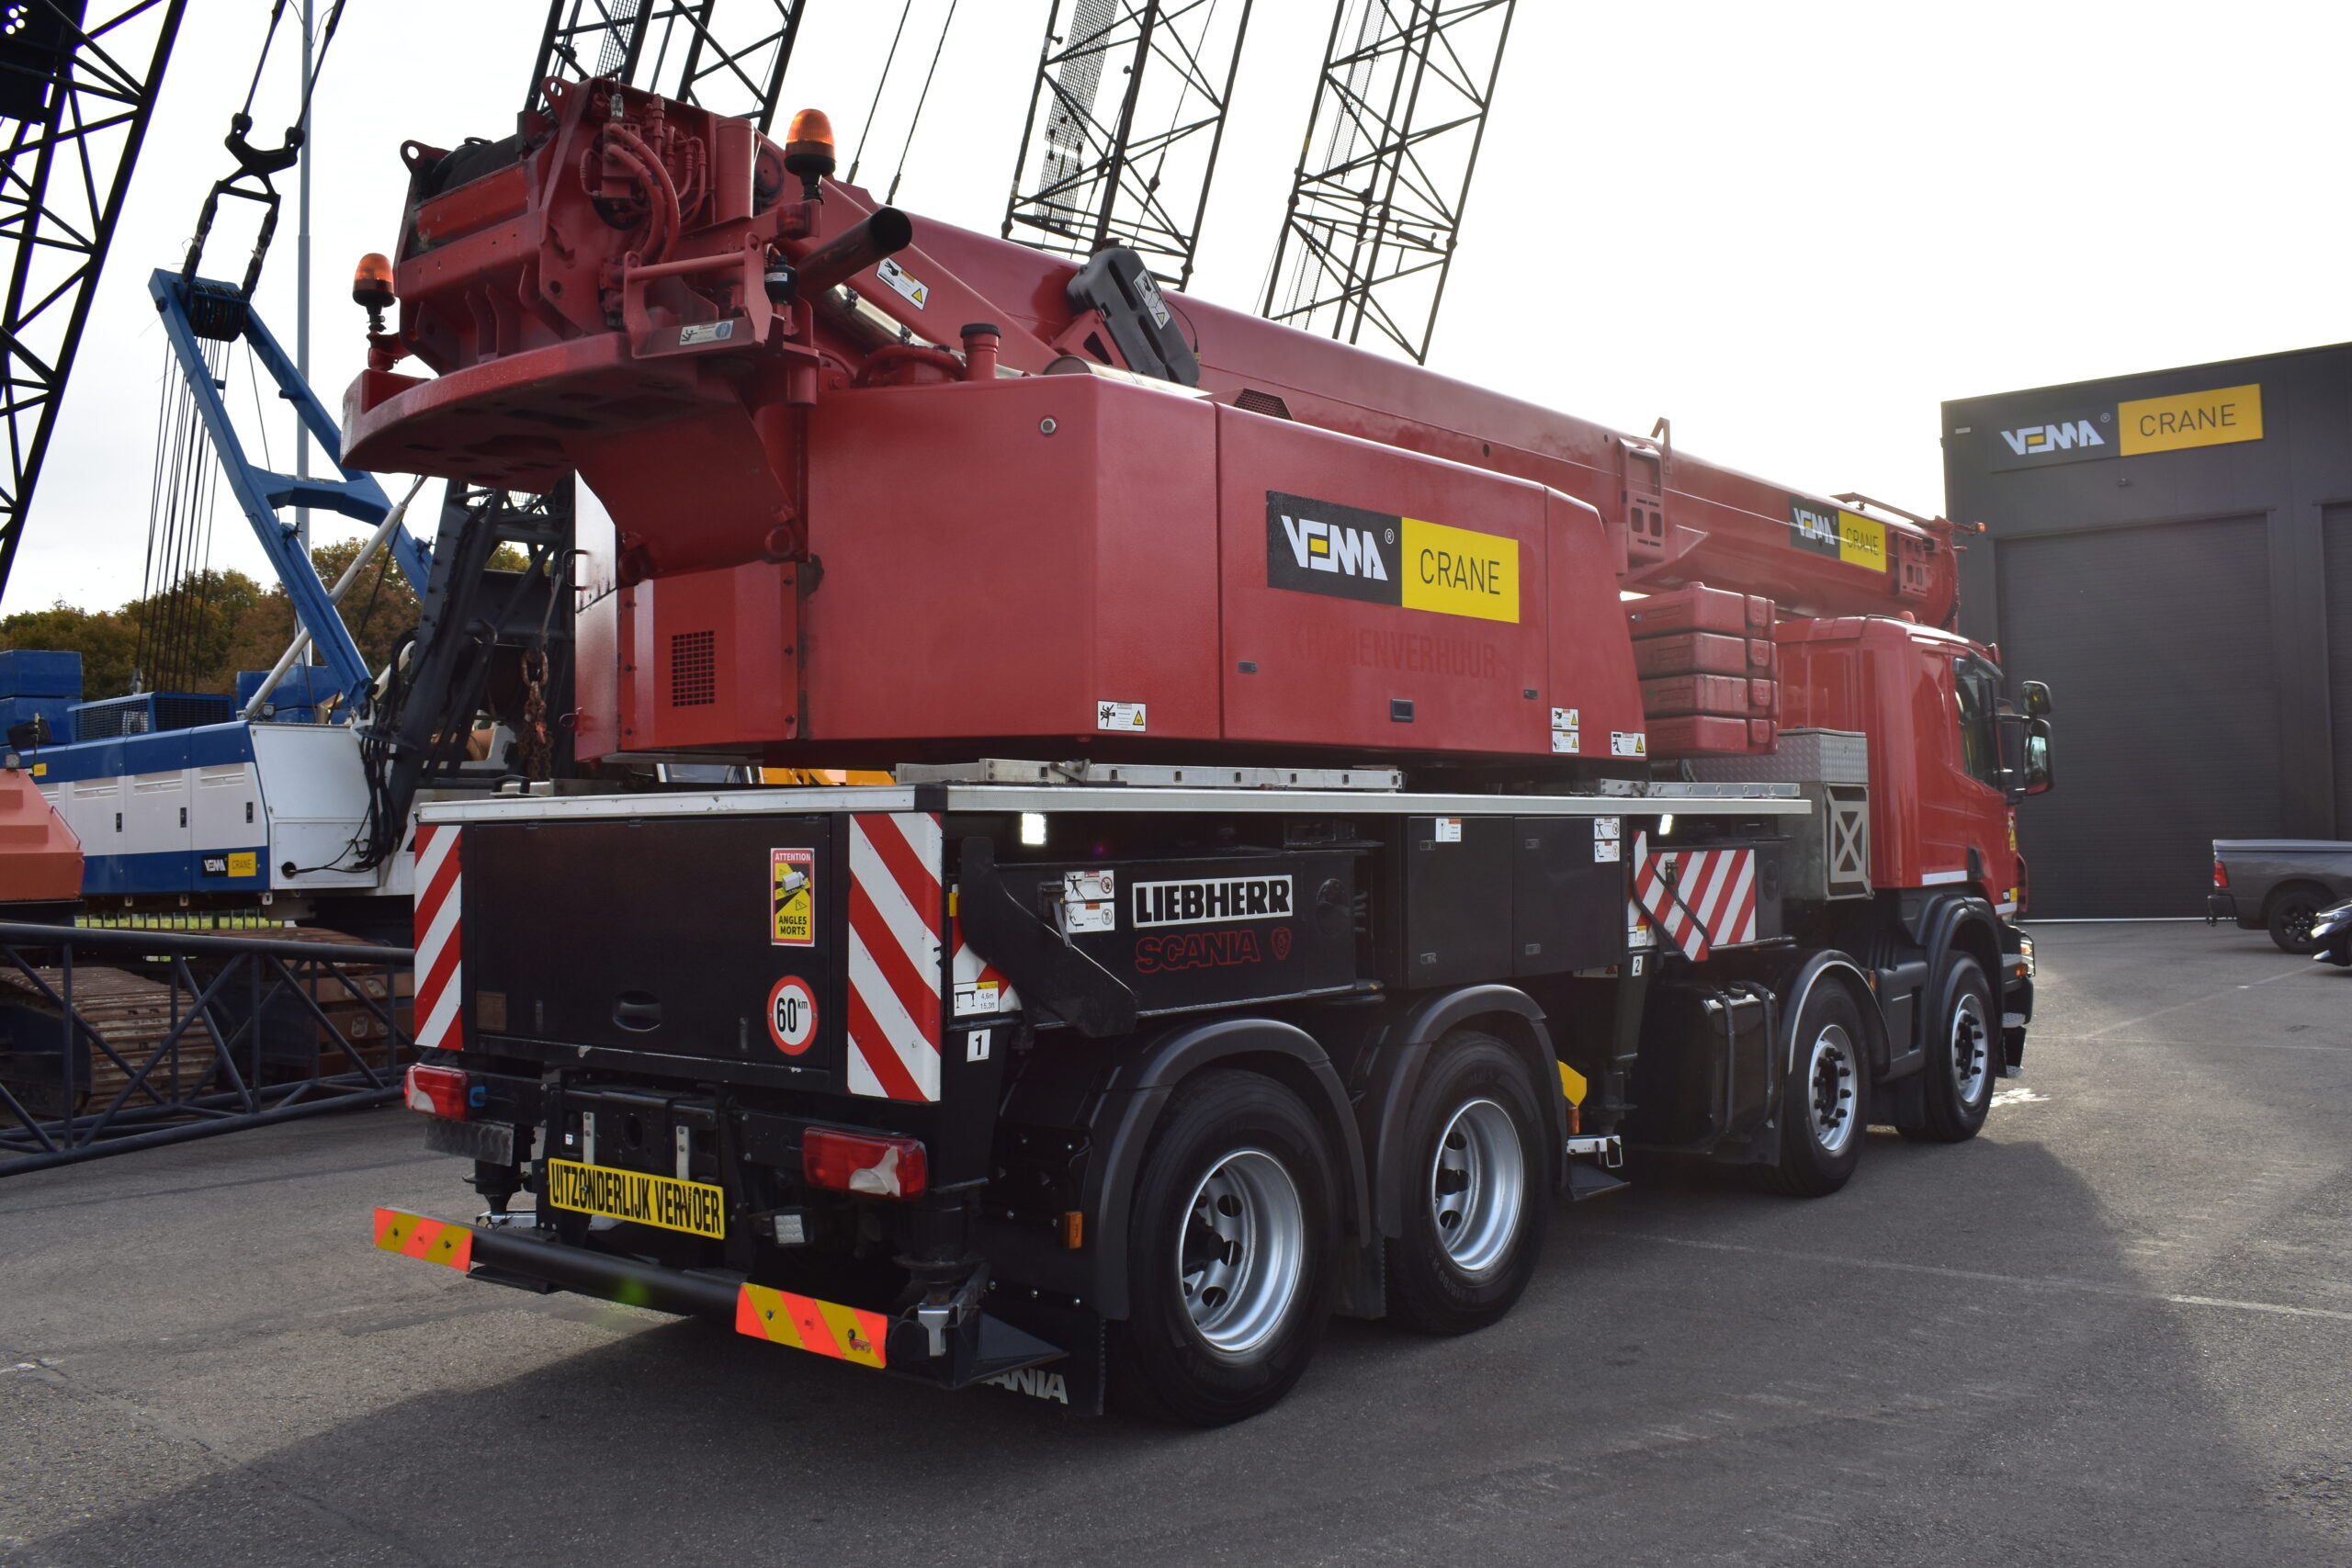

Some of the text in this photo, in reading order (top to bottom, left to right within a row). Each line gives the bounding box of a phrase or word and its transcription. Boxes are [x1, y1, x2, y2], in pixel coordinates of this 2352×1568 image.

[2000, 403, 2237, 456] VEMA CRANE
[1280, 514, 1501, 596] VEMA CRANE
[1845, 526, 1880, 557] CRANE
[775, 852, 812, 862] ATTENTION
[1135, 879, 1291, 924] LIEBHERR
[778, 915, 808, 926] ANGLES
[780, 925, 807, 936] MORTS
[1134, 929, 1262, 975] SCANIA
[1634, 958, 1641, 974] 2
[776, 997, 808, 1033] 60 km
[974, 1033, 983, 1056] 1
[551, 1162, 721, 1235] UITZONDERLIJK VERVOER
[980, 1367, 1069, 1404] ANIA
